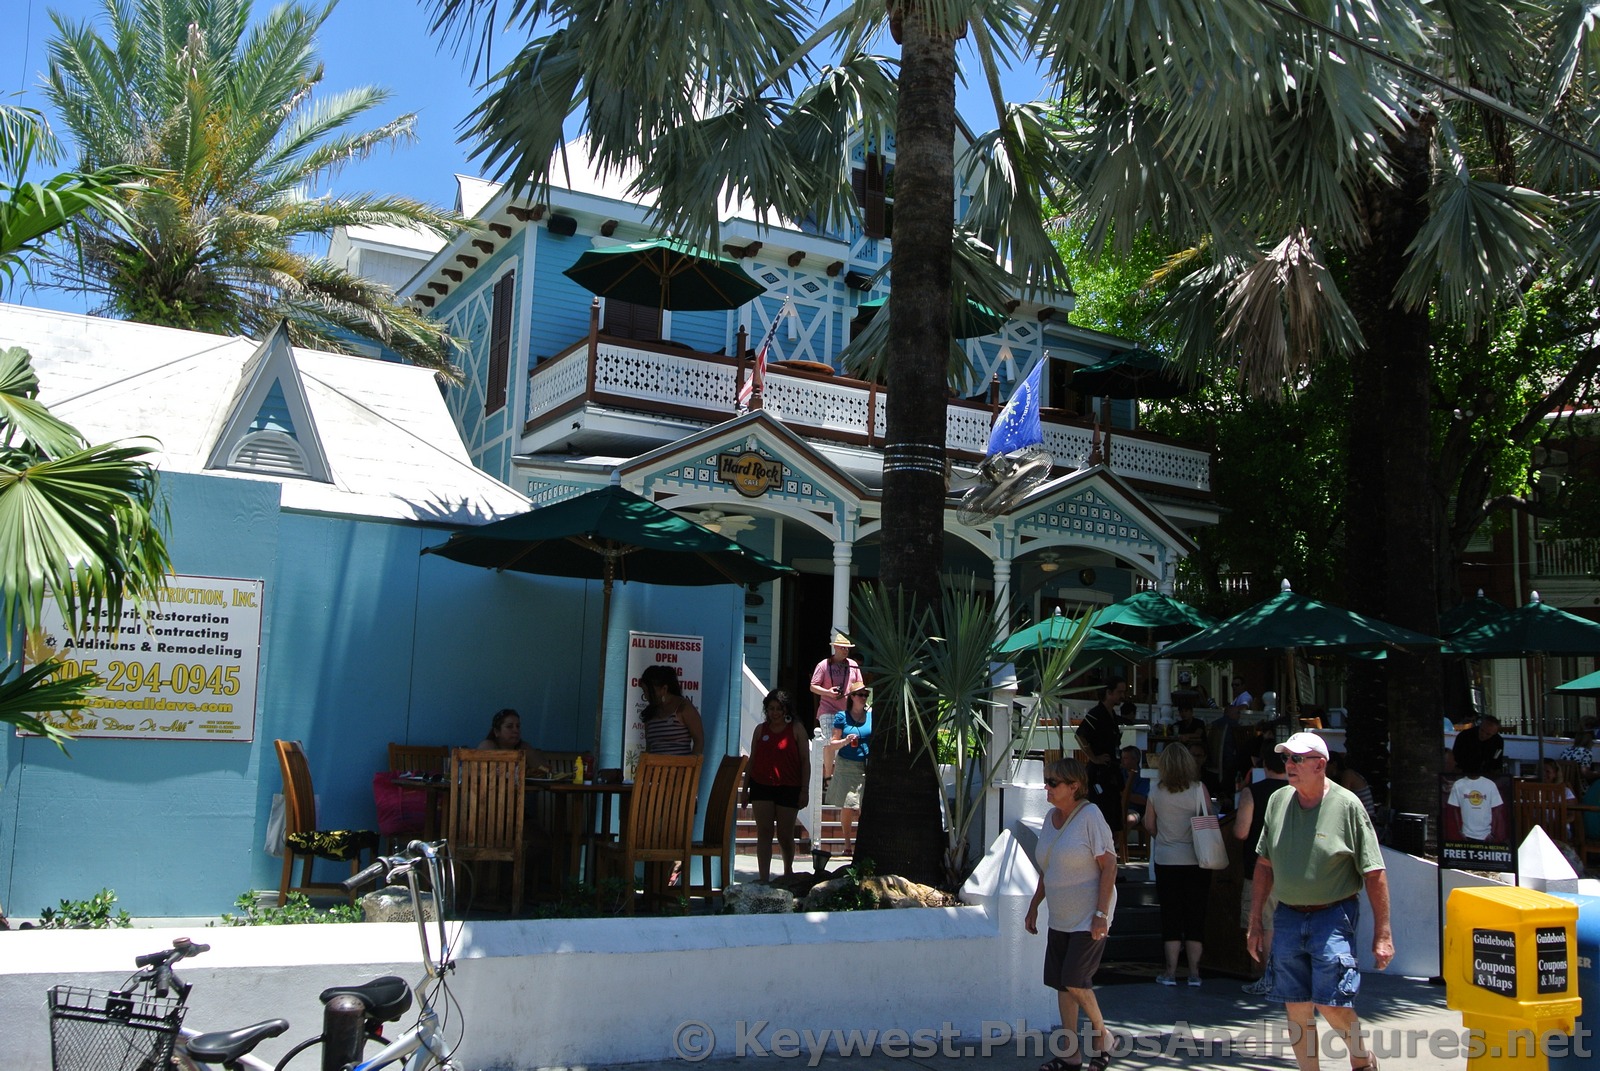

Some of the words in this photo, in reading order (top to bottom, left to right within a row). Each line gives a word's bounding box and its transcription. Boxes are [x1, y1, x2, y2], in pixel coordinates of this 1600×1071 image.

[723, 459, 751, 476] Hard
[752, 462, 779, 482] Rock
[122, 584, 227, 608] CNTRUCTION,
[232, 588, 258, 607] INC.
[146, 610, 229, 624] Restoration
[146, 626, 229, 641] Contracting
[64, 638, 136, 651] Additions
[141, 642, 152, 652] &
[157, 643, 242, 659] Remodeling
[632, 638, 647, 648] ALL
[649, 640, 701, 651] BUSINESSES
[655, 652, 678, 663] OPEN
[58, 697, 234, 713] .onecalldave.com
[1443, 849, 1467, 859] FREE
[1468, 850, 1512, 862] T-SHIRT!
[1473, 934, 1515, 948] Guidebook
[1536, 932, 1566, 943] Guidebook
[1474, 958, 1515, 974] Coupons
[1538, 959, 1567, 972] Coupons
[1477, 974, 1485, 985] &
[1487, 975, 1513, 991] Maps
[1541, 974, 1547, 986] &
[1548, 974, 1566, 988] Maps
